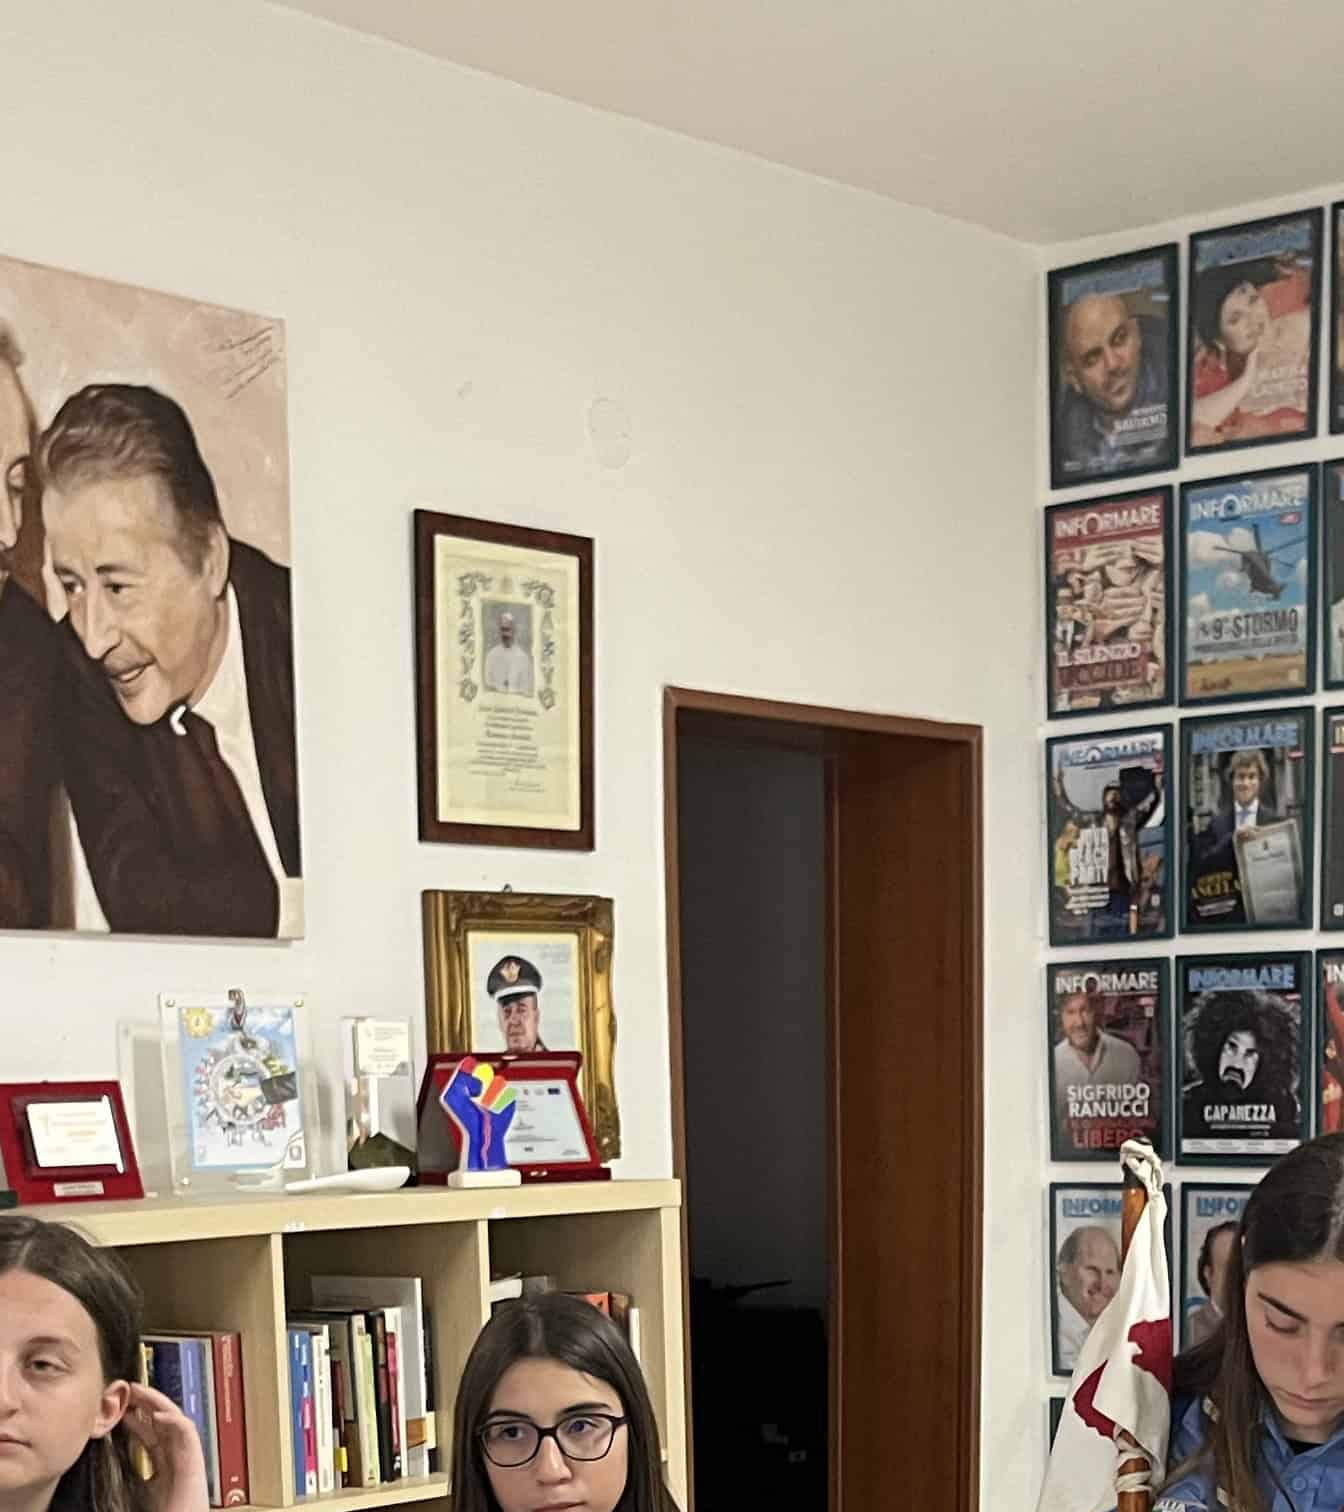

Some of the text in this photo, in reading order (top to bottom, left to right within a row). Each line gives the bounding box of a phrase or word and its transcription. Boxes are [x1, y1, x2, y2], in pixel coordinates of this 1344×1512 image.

[1056, 505, 1160, 537] INFORMARE
[1056, 972, 1158, 995] INFORMARE
[1067, 1083, 1150, 1101] SIGFRIDO
[1069, 1099, 1149, 1118] RANUCCI
[1204, 1104, 1276, 1122] CAPAREZZA
